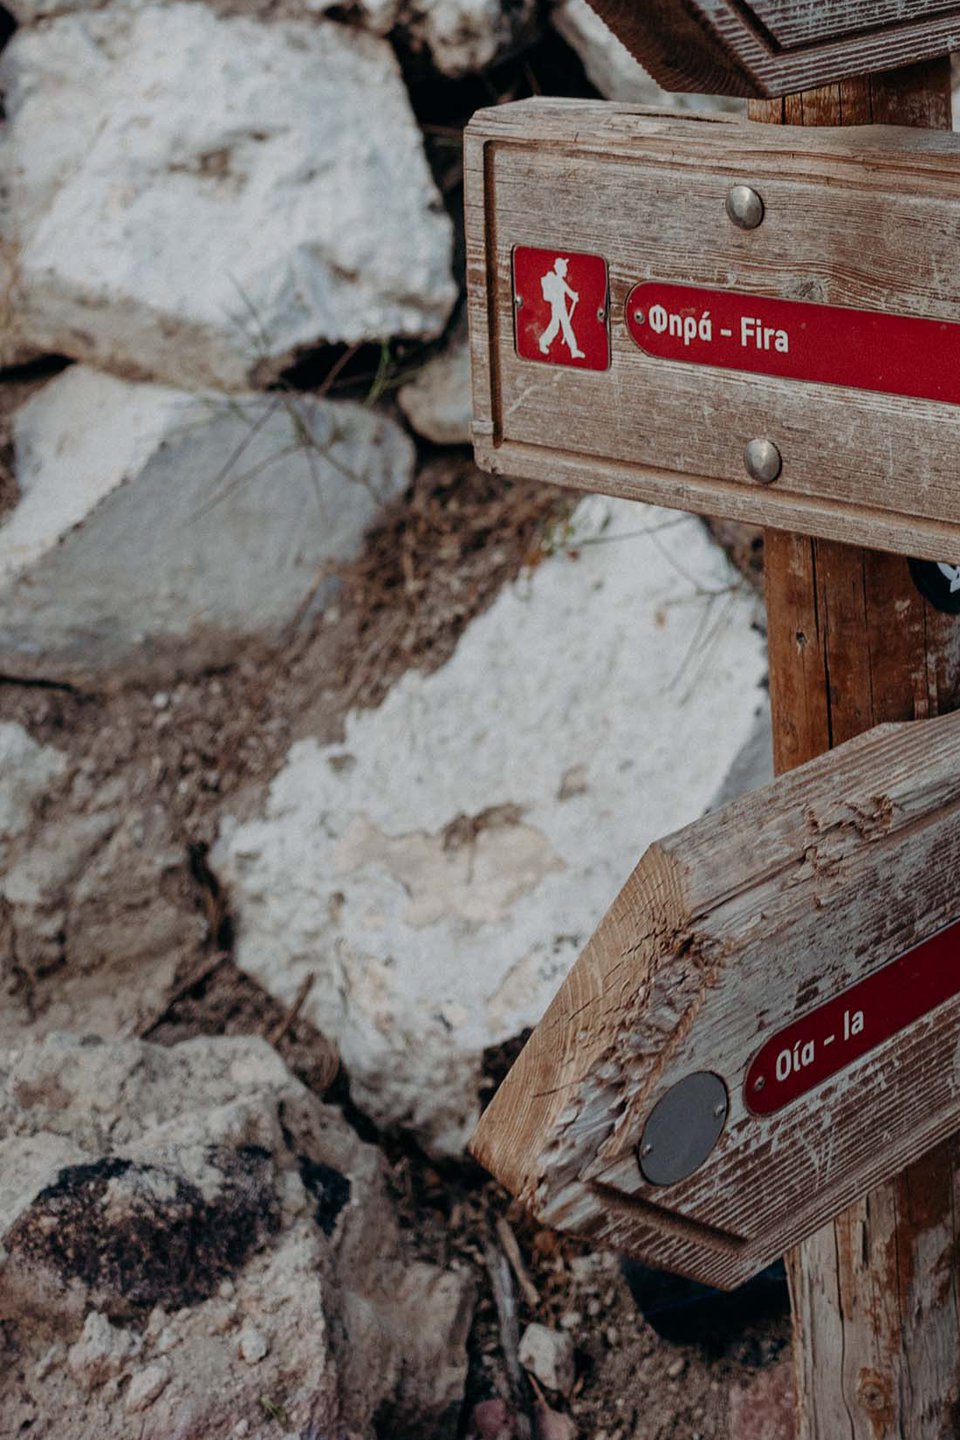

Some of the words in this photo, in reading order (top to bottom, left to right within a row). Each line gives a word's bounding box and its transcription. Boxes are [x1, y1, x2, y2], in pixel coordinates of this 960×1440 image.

[648, 303, 713, 347] Φηρά
[740, 315, 790, 354] Fira
[775, 1038, 815, 1082] Οία
[843, 1008, 865, 1042] Ia
